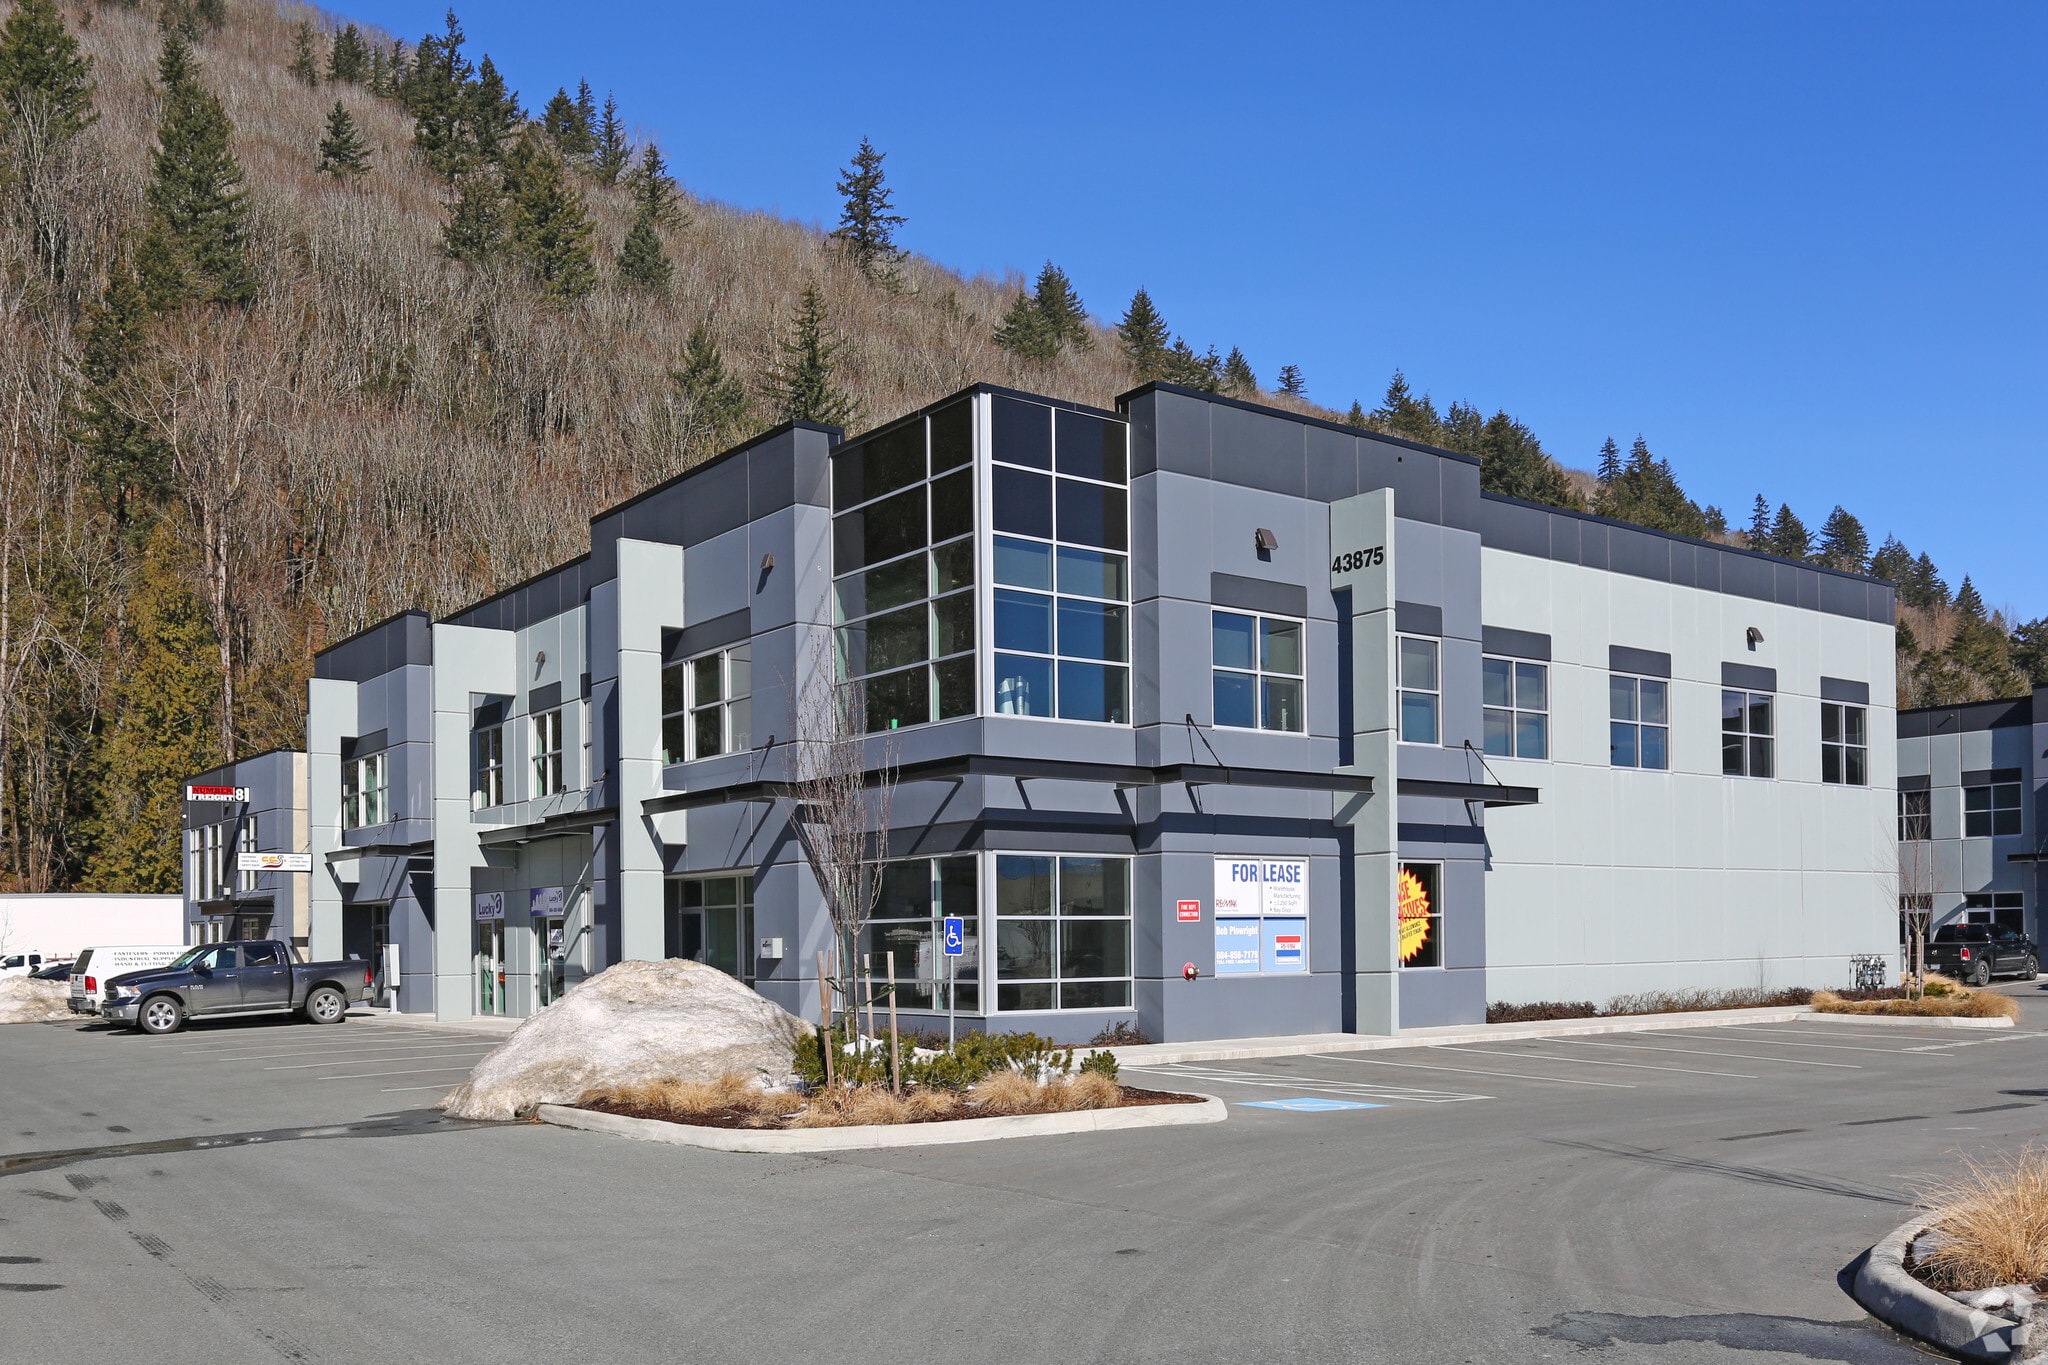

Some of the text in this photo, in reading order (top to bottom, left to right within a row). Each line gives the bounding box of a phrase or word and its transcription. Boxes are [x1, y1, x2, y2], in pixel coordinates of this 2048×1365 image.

[1332, 546, 1384, 574] 43875
[192, 786, 234, 795] NUMBER
[235, 788, 244, 801] 8
[1232, 864, 1301, 883] FOR LEASE
[1229, 925, 1258, 936] Plowright
